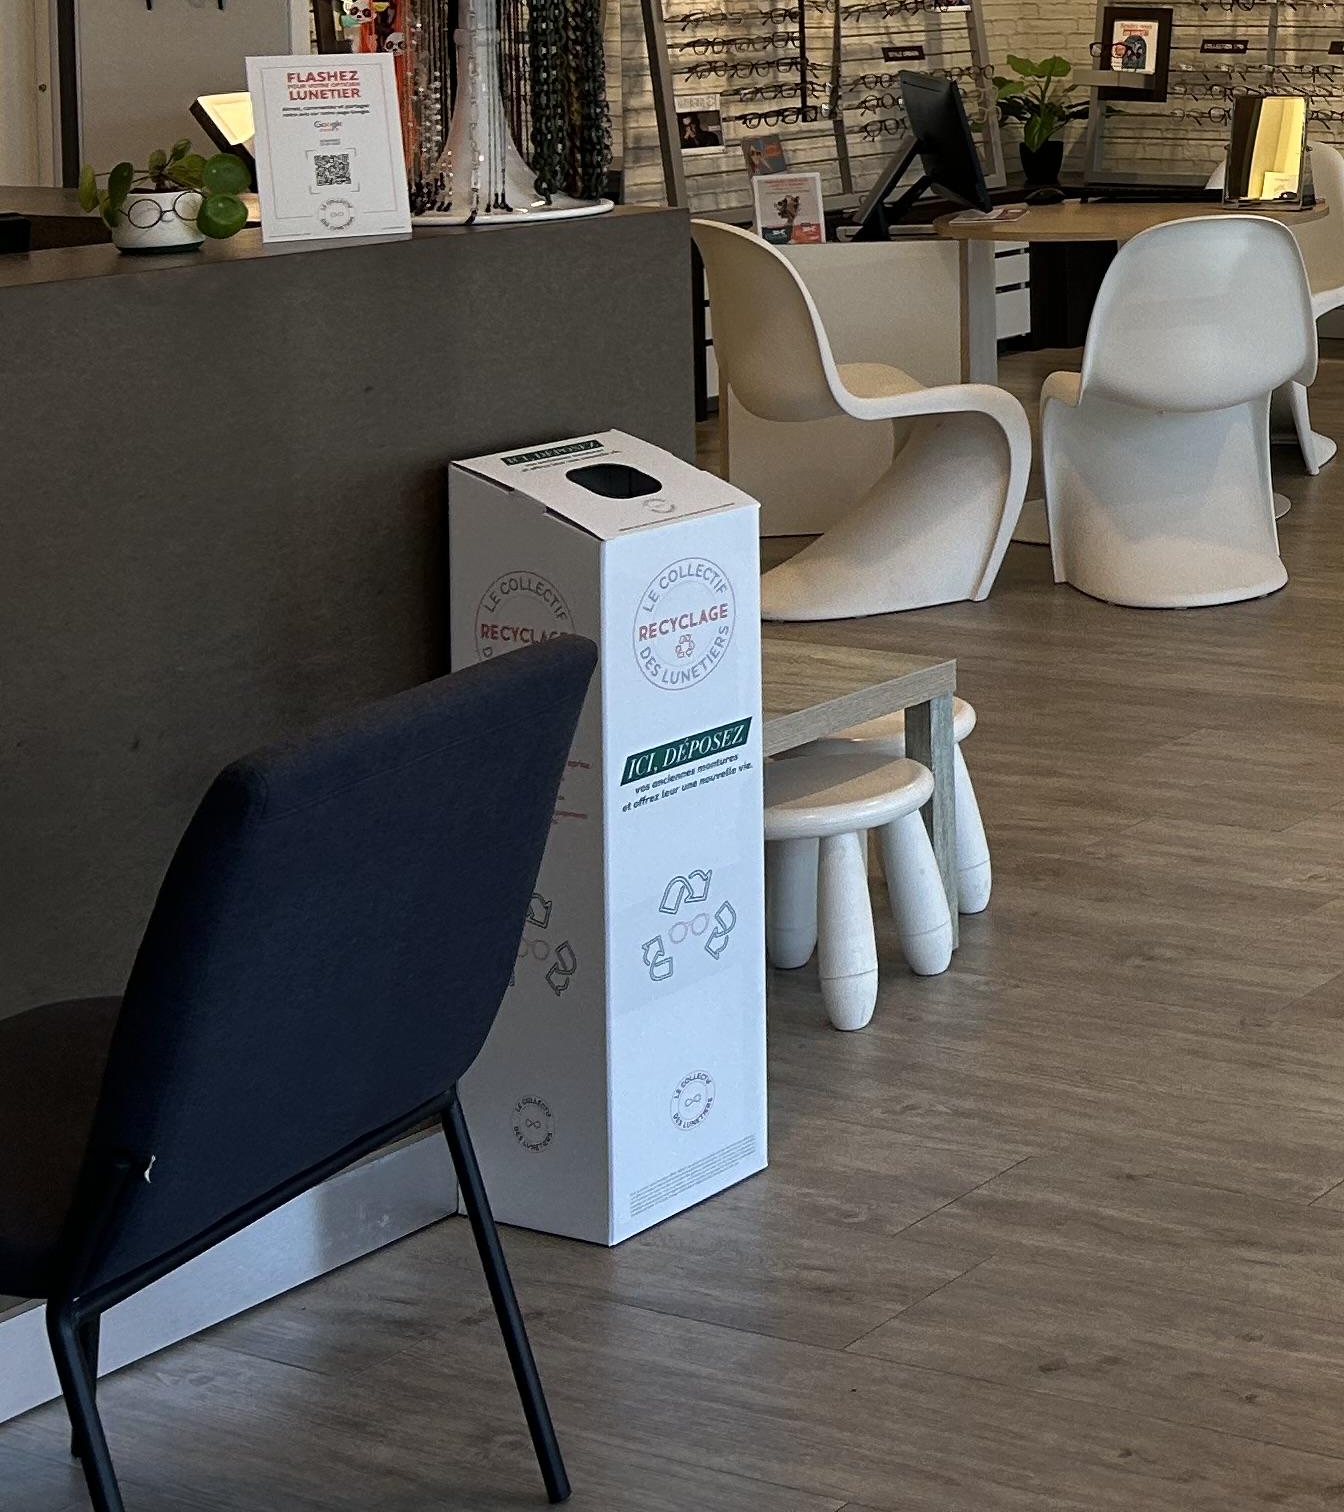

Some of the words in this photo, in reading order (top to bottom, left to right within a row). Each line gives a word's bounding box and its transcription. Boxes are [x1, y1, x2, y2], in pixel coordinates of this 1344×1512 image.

[287, 70, 360, 83] FLASHEZ
[289, 88, 361, 101] LUNETIER
[484, 592, 501, 613] LE
[501, 577, 568, 620] COLLECTIF
[643, 592, 658, 612] LE
[659, 563, 728, 595] COLLECTIF
[481, 623, 570, 645] RECYCLA
[638, 603, 729, 641] RECYCLAGE
[640, 646, 661, 677] DES
[661, 624, 729, 684] LUNETIERS
[628, 758, 659, 780] ICI,
[662, 724, 744, 767] DÉPOSEZ
[635, 783, 650, 794] vos
[652, 767, 696, 789] anciennes
[697, 753, 739, 774] montures
[622, 801, 632, 812] et
[633, 792, 660, 811] offrez
[661, 785, 680, 800] leur
